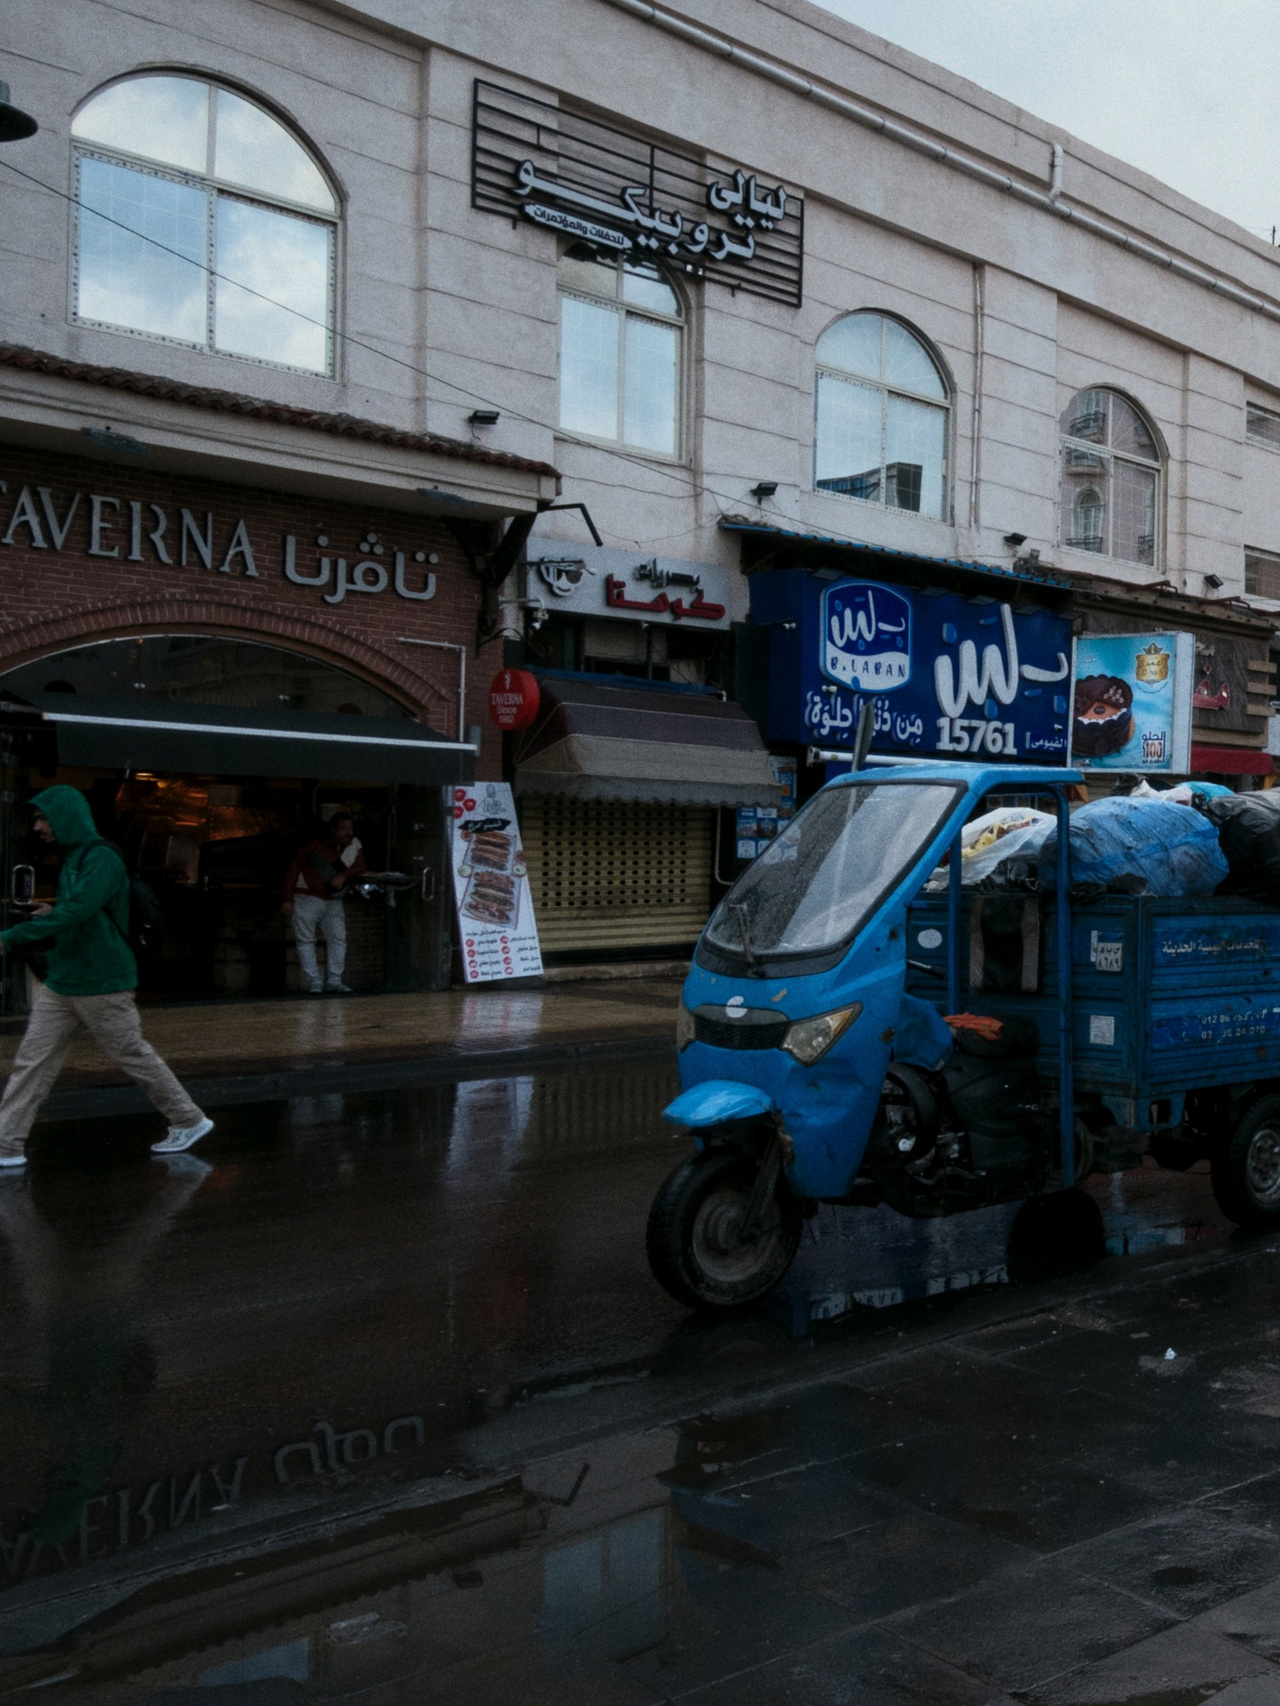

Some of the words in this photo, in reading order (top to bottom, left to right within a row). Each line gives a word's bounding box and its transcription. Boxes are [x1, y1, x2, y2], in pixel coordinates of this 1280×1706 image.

[0, 479, 259, 578] AVERNA
[490, 692, 524, 706] TAVERNA
[496, 705, 517, 715] Since
[935, 718, 1018, 756] 15761
[1145, 742, 1162, 758] 100
[1201, 1015, 1218, 1025] 012
[1201, 1030, 1213, 1040] 03
